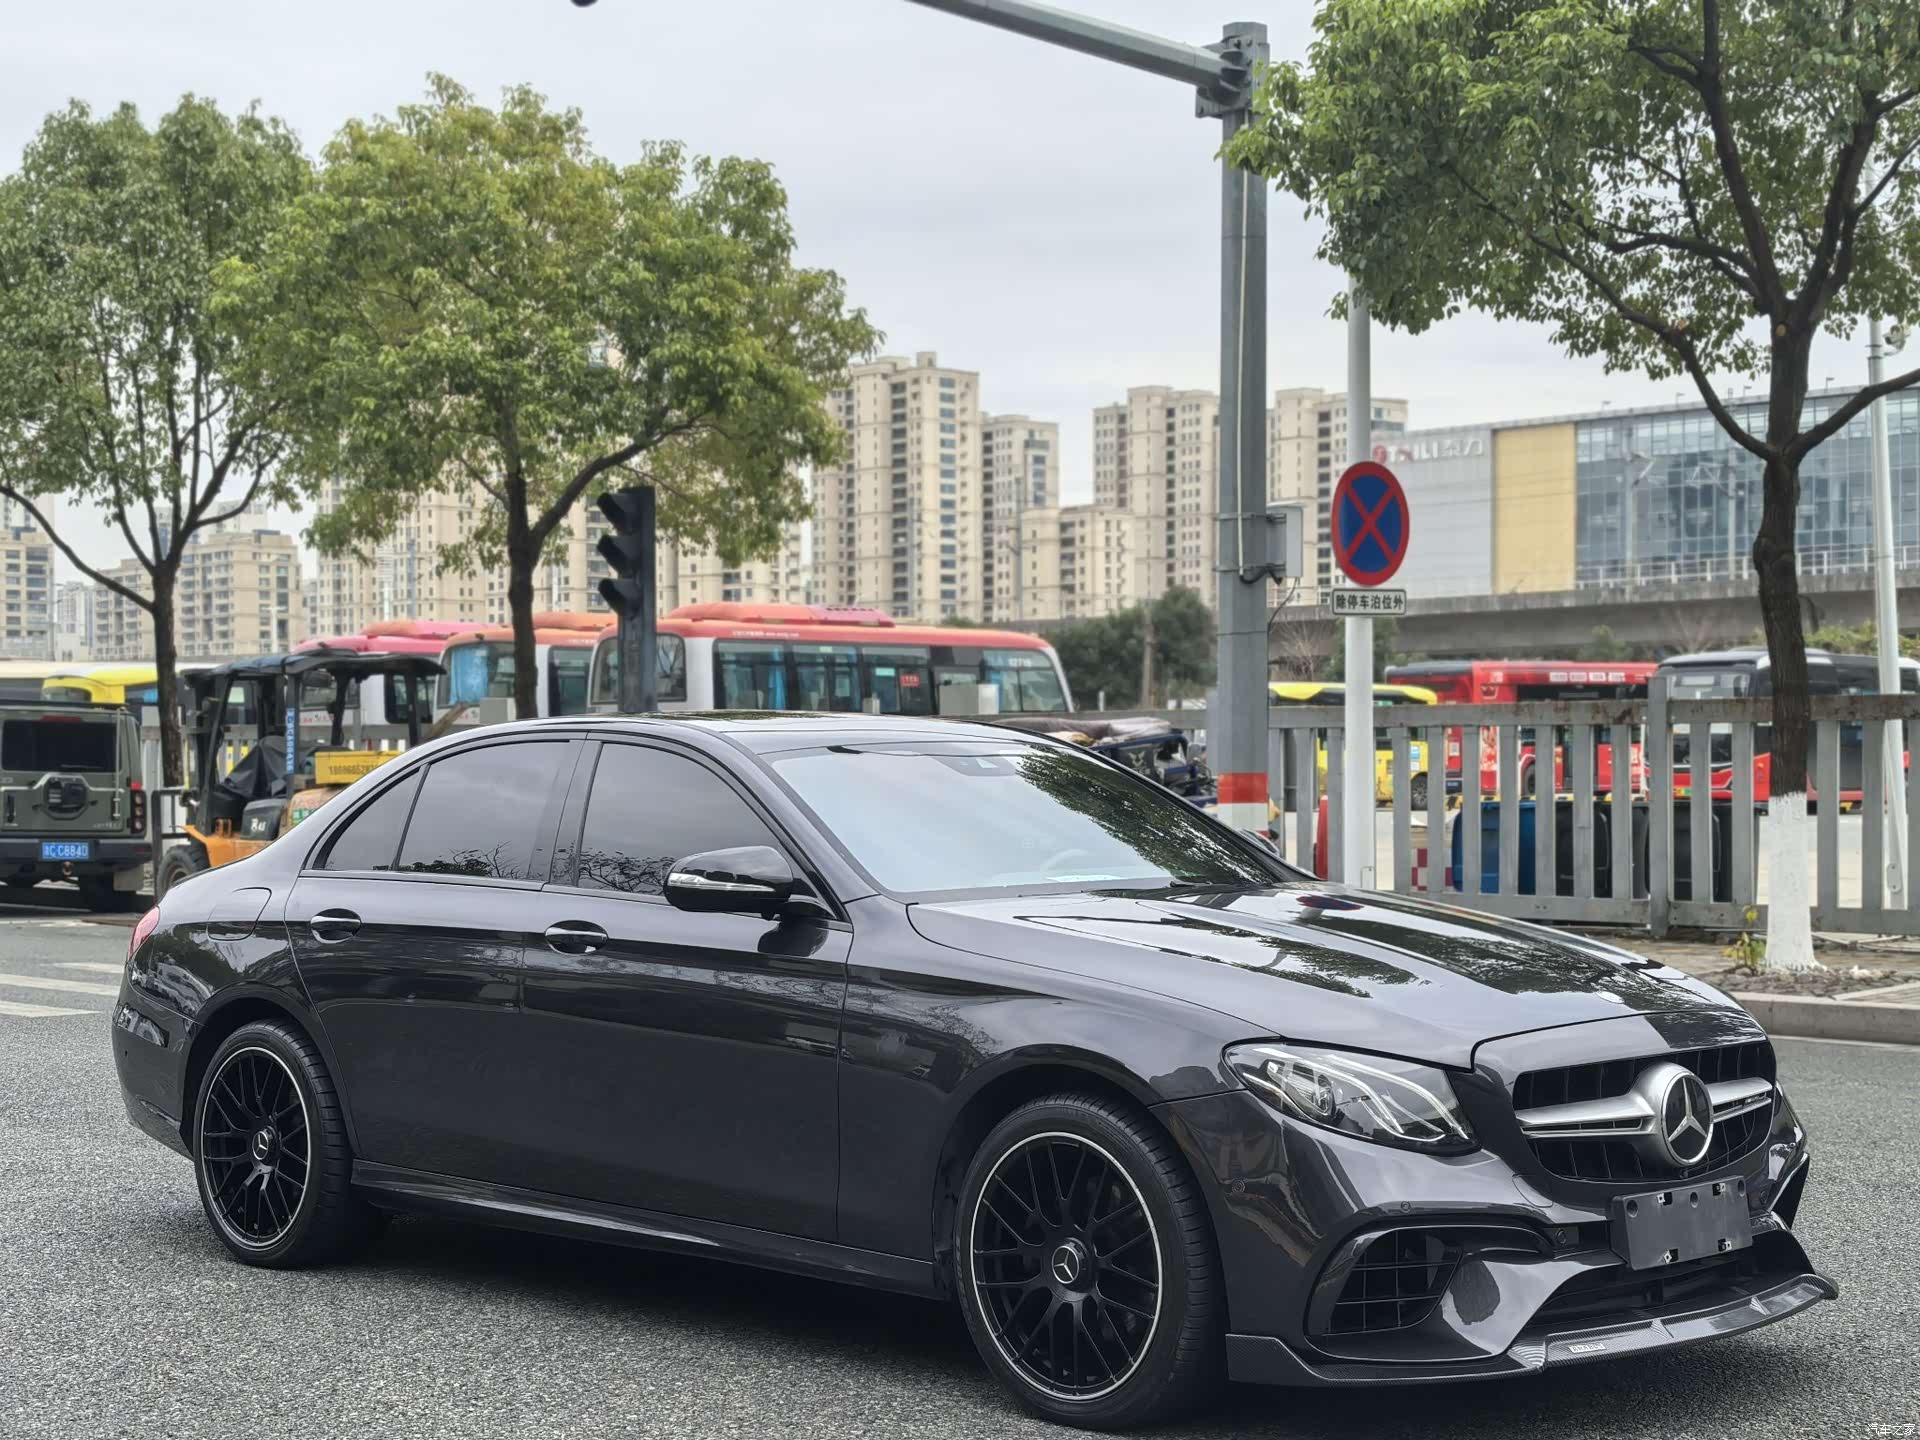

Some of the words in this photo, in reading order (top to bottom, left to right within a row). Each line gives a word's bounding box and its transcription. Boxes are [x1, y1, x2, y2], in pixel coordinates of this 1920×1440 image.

[1335, 594, 1403, 610] 除停车泊位外
